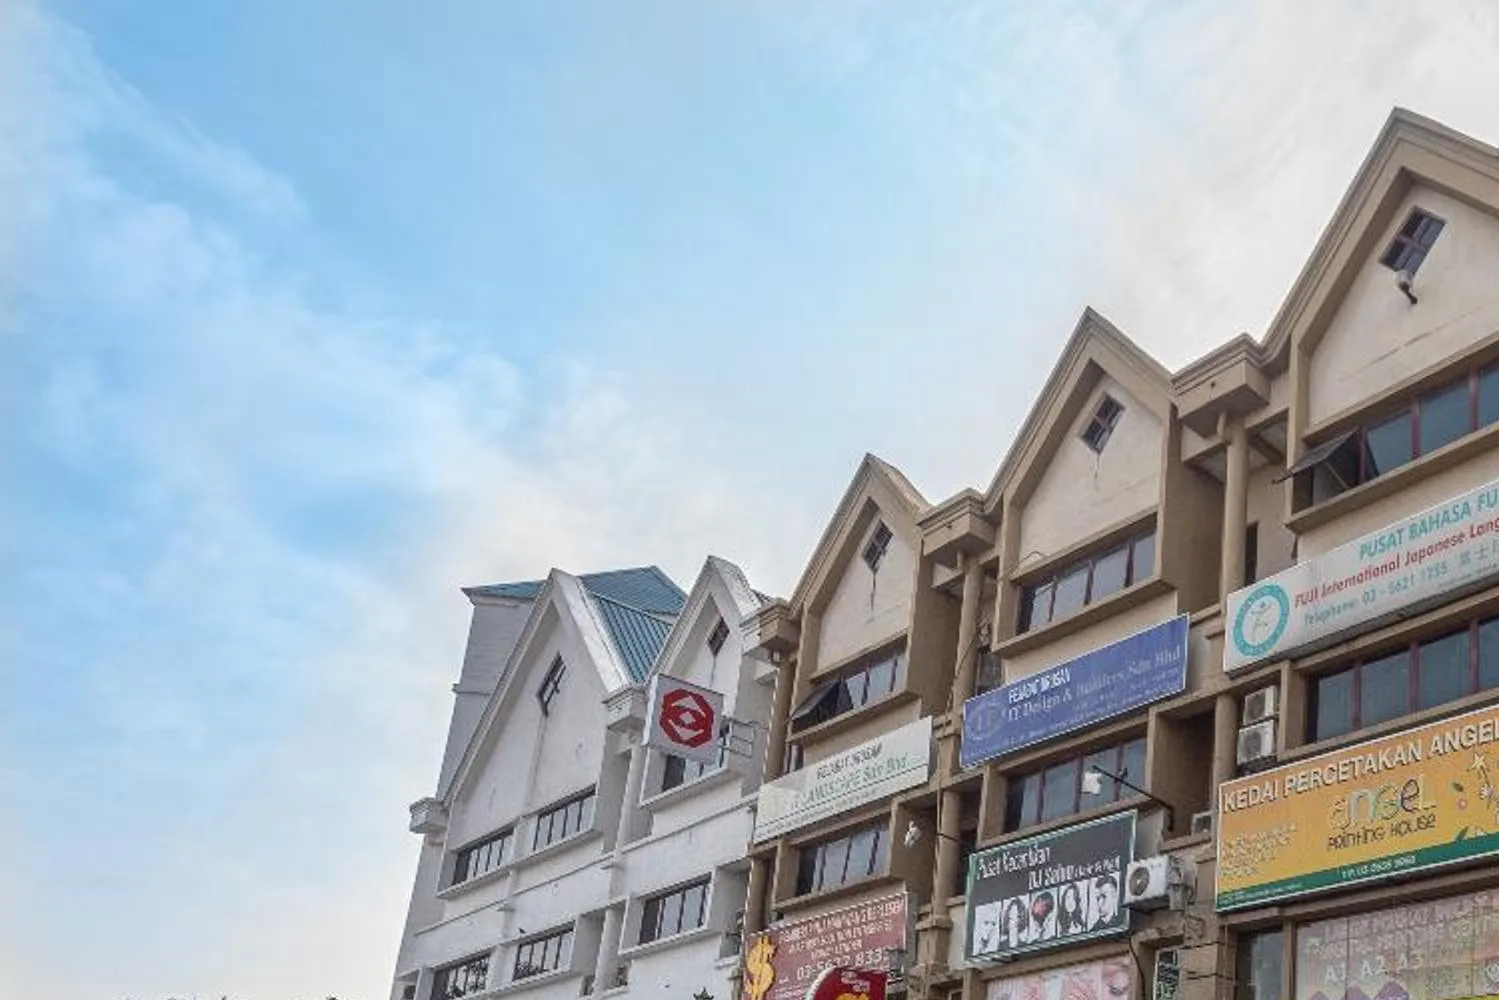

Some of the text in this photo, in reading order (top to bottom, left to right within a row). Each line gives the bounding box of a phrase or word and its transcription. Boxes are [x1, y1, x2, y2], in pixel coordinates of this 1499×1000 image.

[1359, 528, 1405, 561] PUSAT
[1408, 502, 1471, 541] BAHASA
[1321, 554, 1400, 598] International
[1405, 530, 1465, 567] Japanese
[1222, 781, 1278, 813] KEDAI
[1283, 737, 1422, 799] PERCETAKAN
[1325, 962, 1346, 981] A1
[1361, 955, 1385, 976] A2
